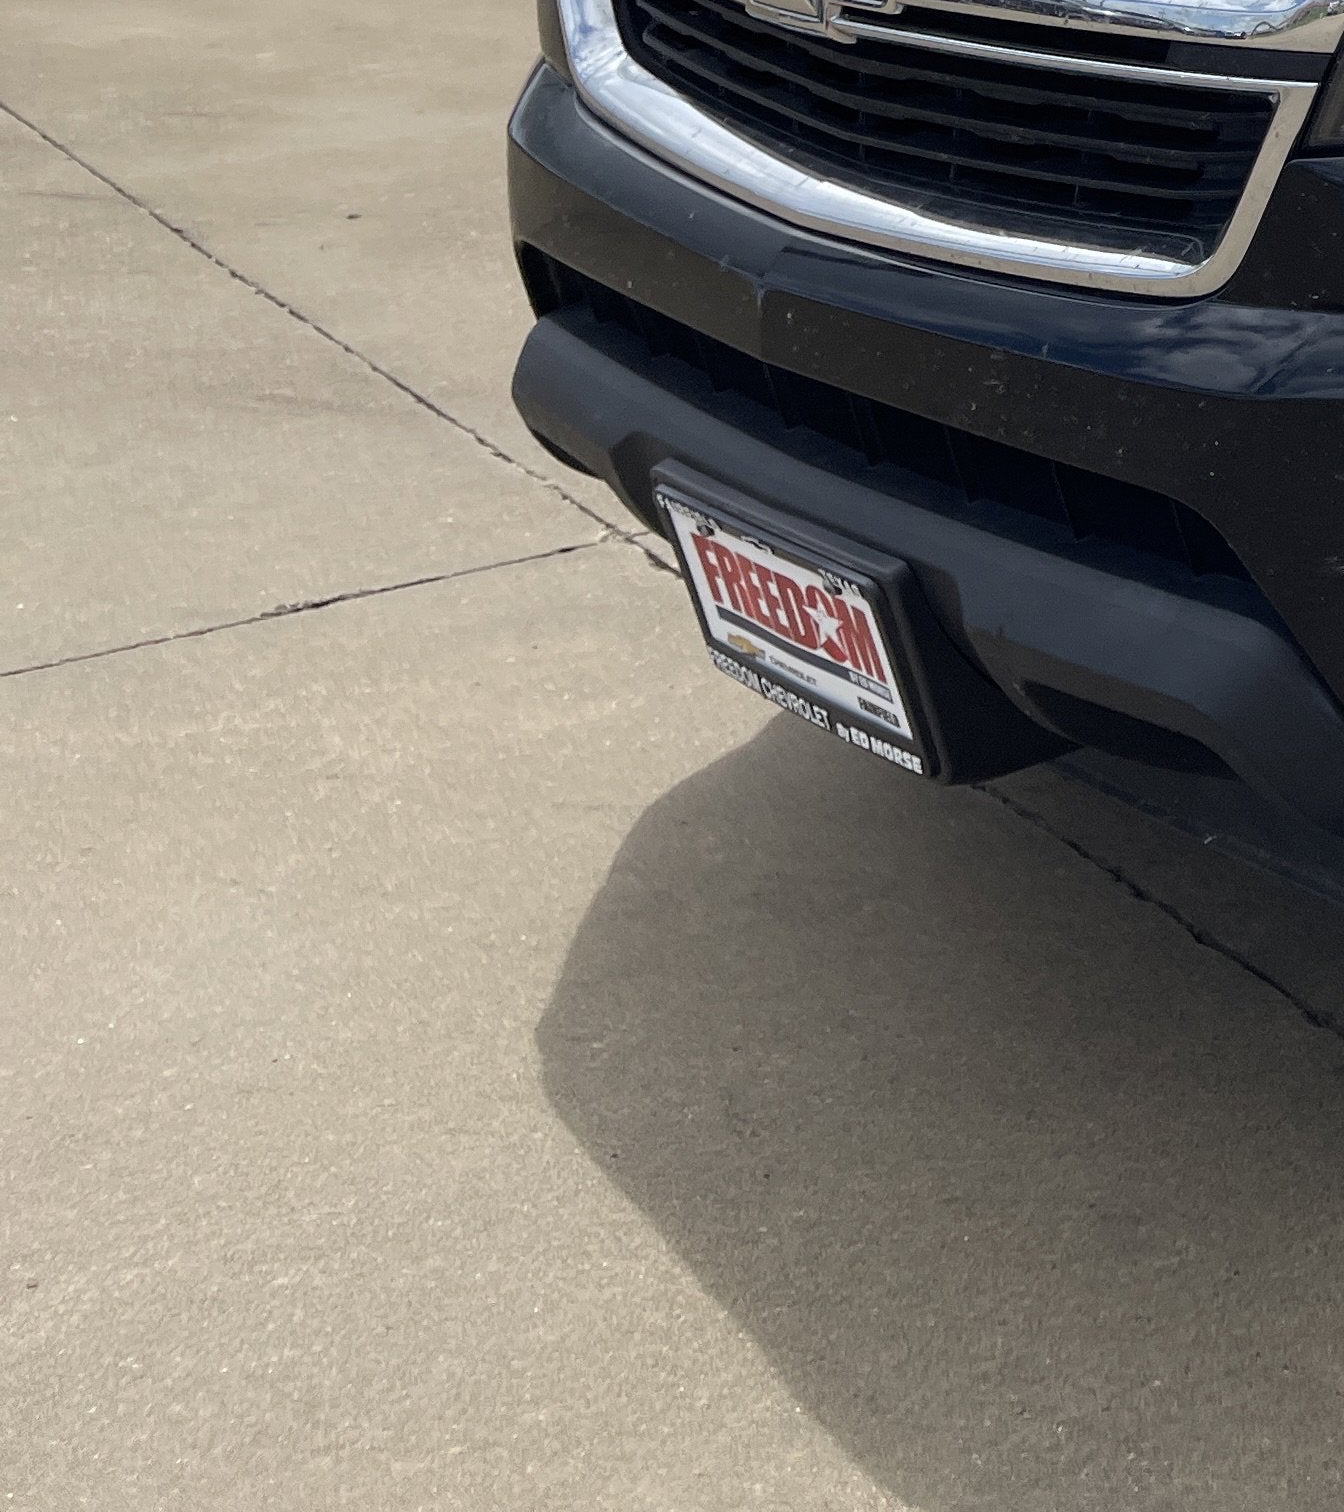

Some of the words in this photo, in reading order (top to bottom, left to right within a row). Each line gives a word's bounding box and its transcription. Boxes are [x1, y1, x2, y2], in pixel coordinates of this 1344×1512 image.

[690, 532, 888, 685] FREEDOM
[760, 677, 831, 730] CHEVROLET
[849, 726, 870, 750] ED
[870, 736, 923, 775] MORSE
